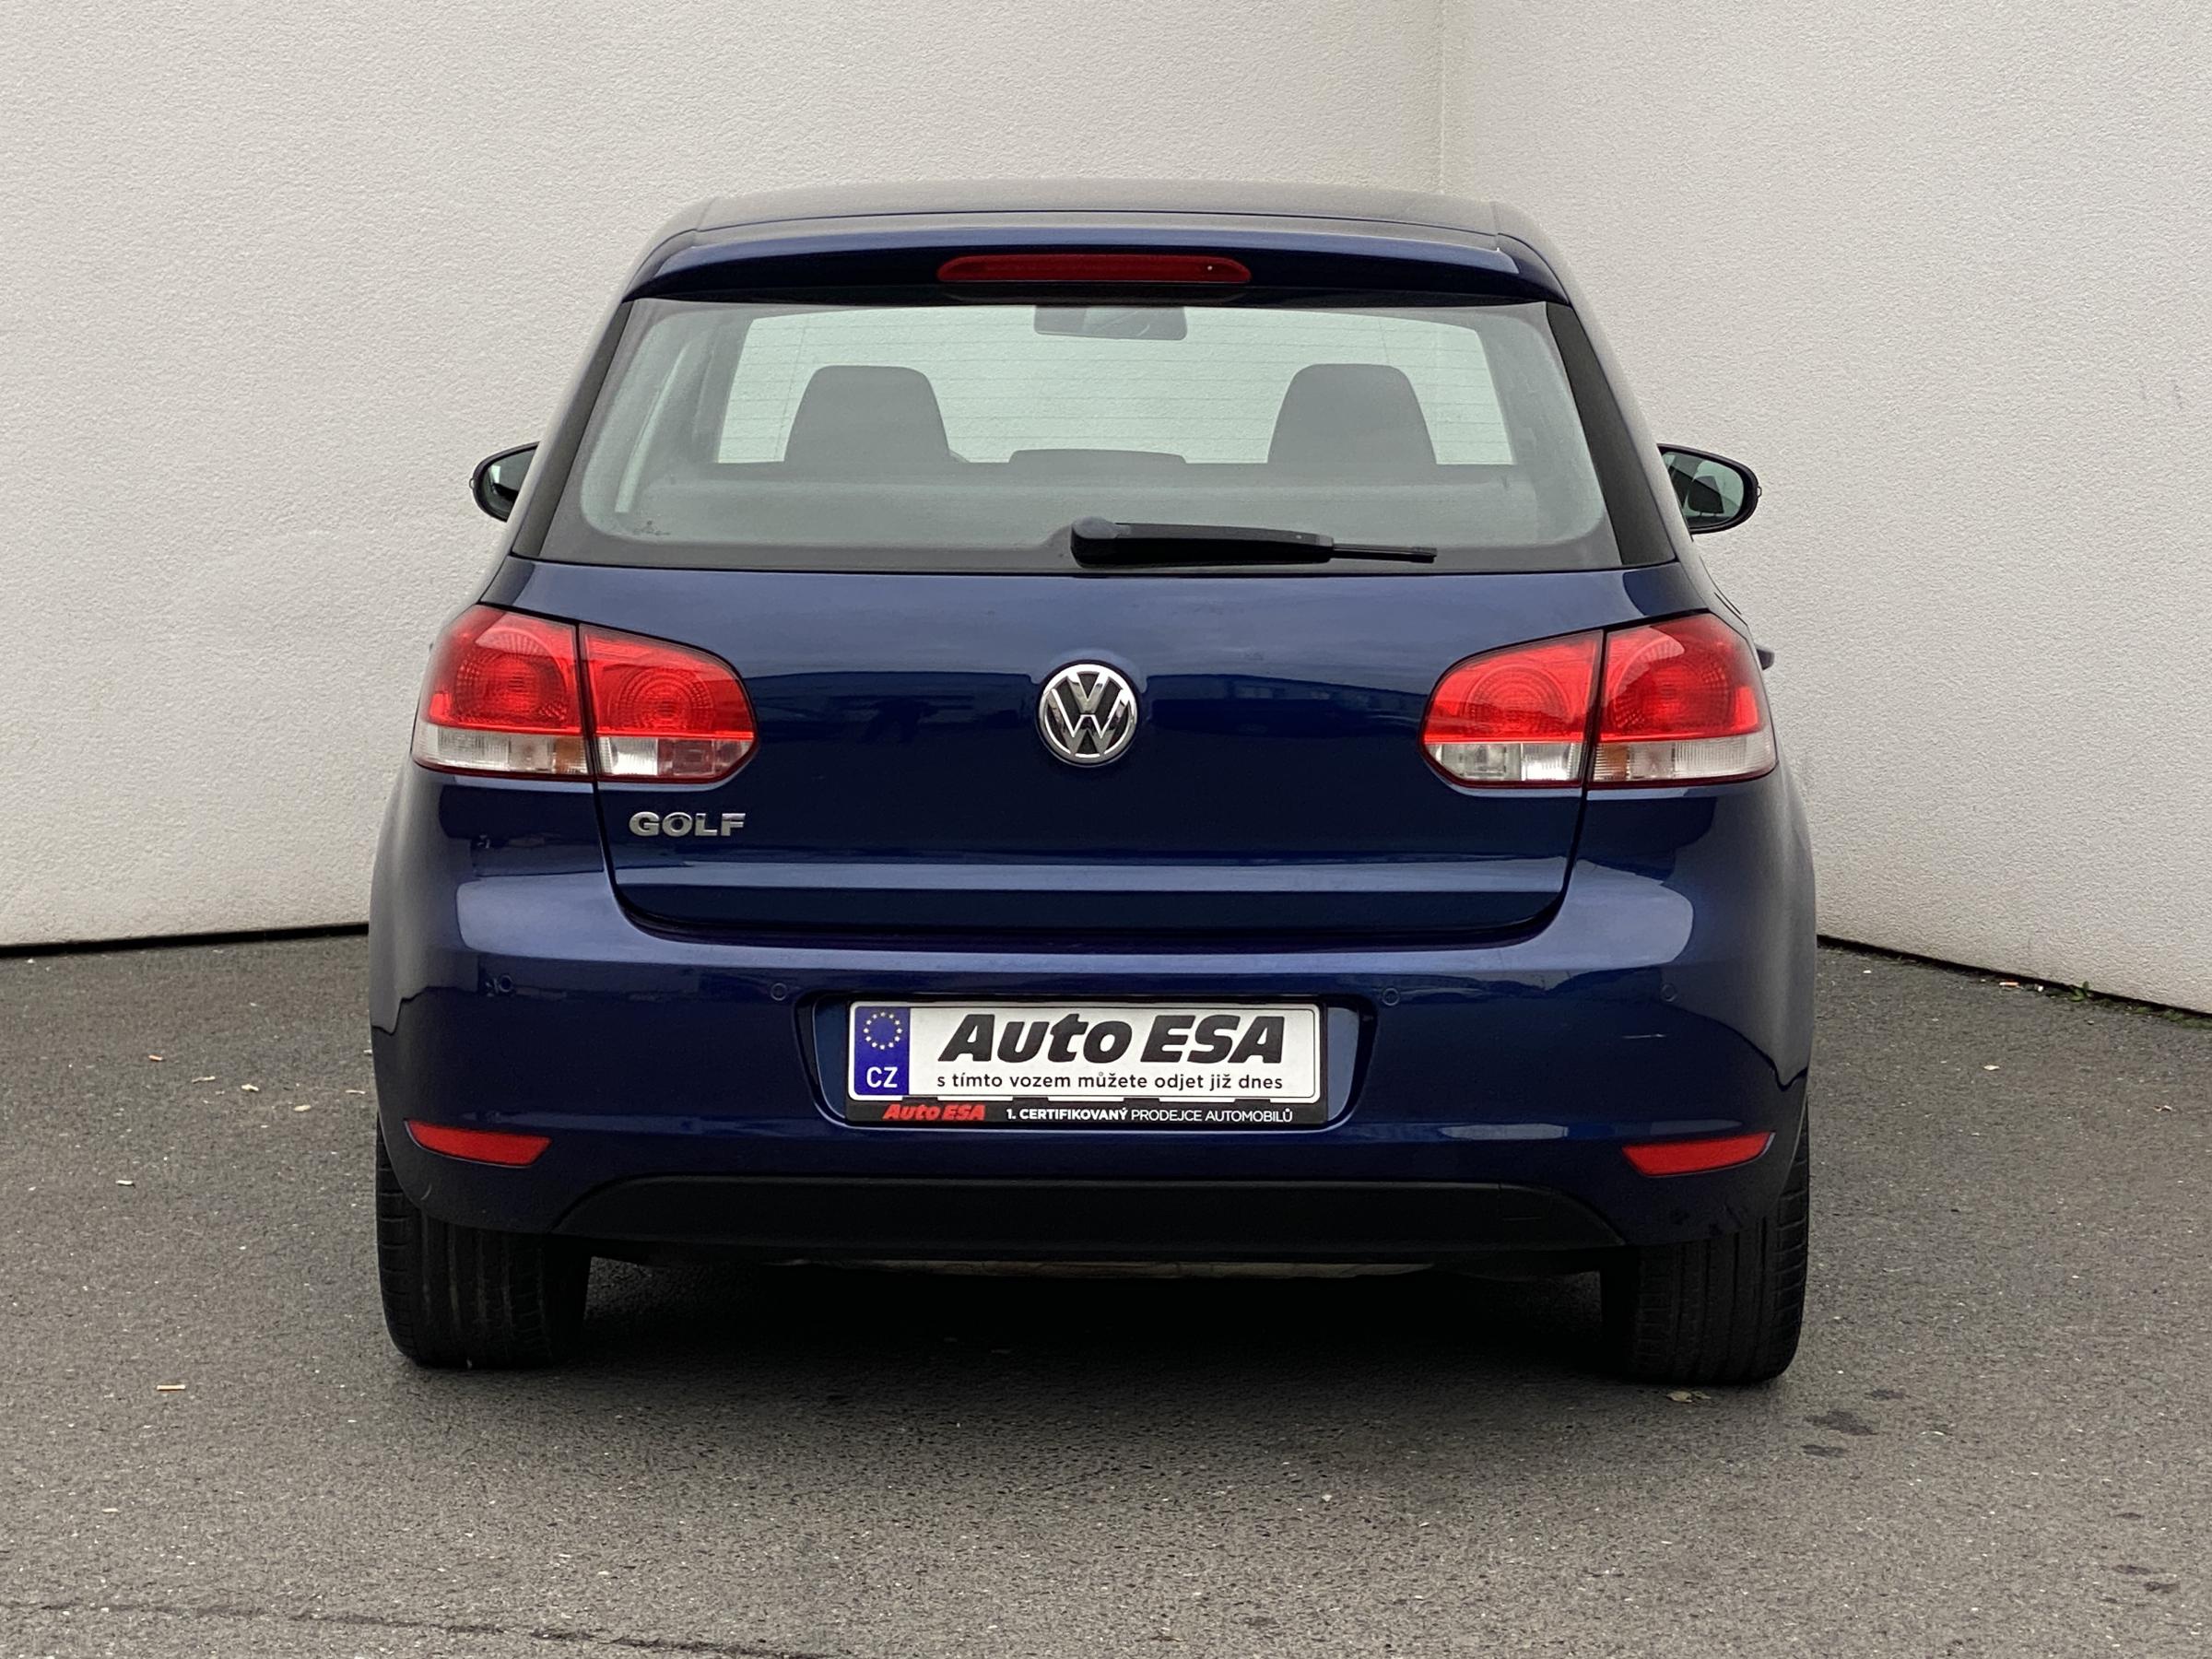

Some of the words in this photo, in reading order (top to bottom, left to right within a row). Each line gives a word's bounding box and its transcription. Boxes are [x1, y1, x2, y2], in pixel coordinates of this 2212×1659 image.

[629, 811, 746, 837] GOLF
[937, 1014, 1133, 1064] Auto
[1139, 1015, 1285, 1064] ESA
[865, 1066, 898, 1088] CZ
[937, 1076, 946, 1088] s
[951, 1072, 1003, 1088] tímto
[1009, 1075, 1071, 1088] vozem
[1077, 1072, 1147, 1089] můžete
[1154, 1074, 1204, 1094] odjet
[1208, 1074, 1232, 1094] již
[1238, 1074, 1283, 1089] dnes
[883, 1104, 939, 1121] Auto
[942, 1104, 985, 1121] ESA
[1006, 1108, 1016, 1121] 1.
[1018, 1106, 1128, 1121] CERTIFIKOVANÝ
[1131, 1110, 1202, 1122] PRODEJCE
[1205, 1108, 1293, 1123] AUTOMOBILŮ
